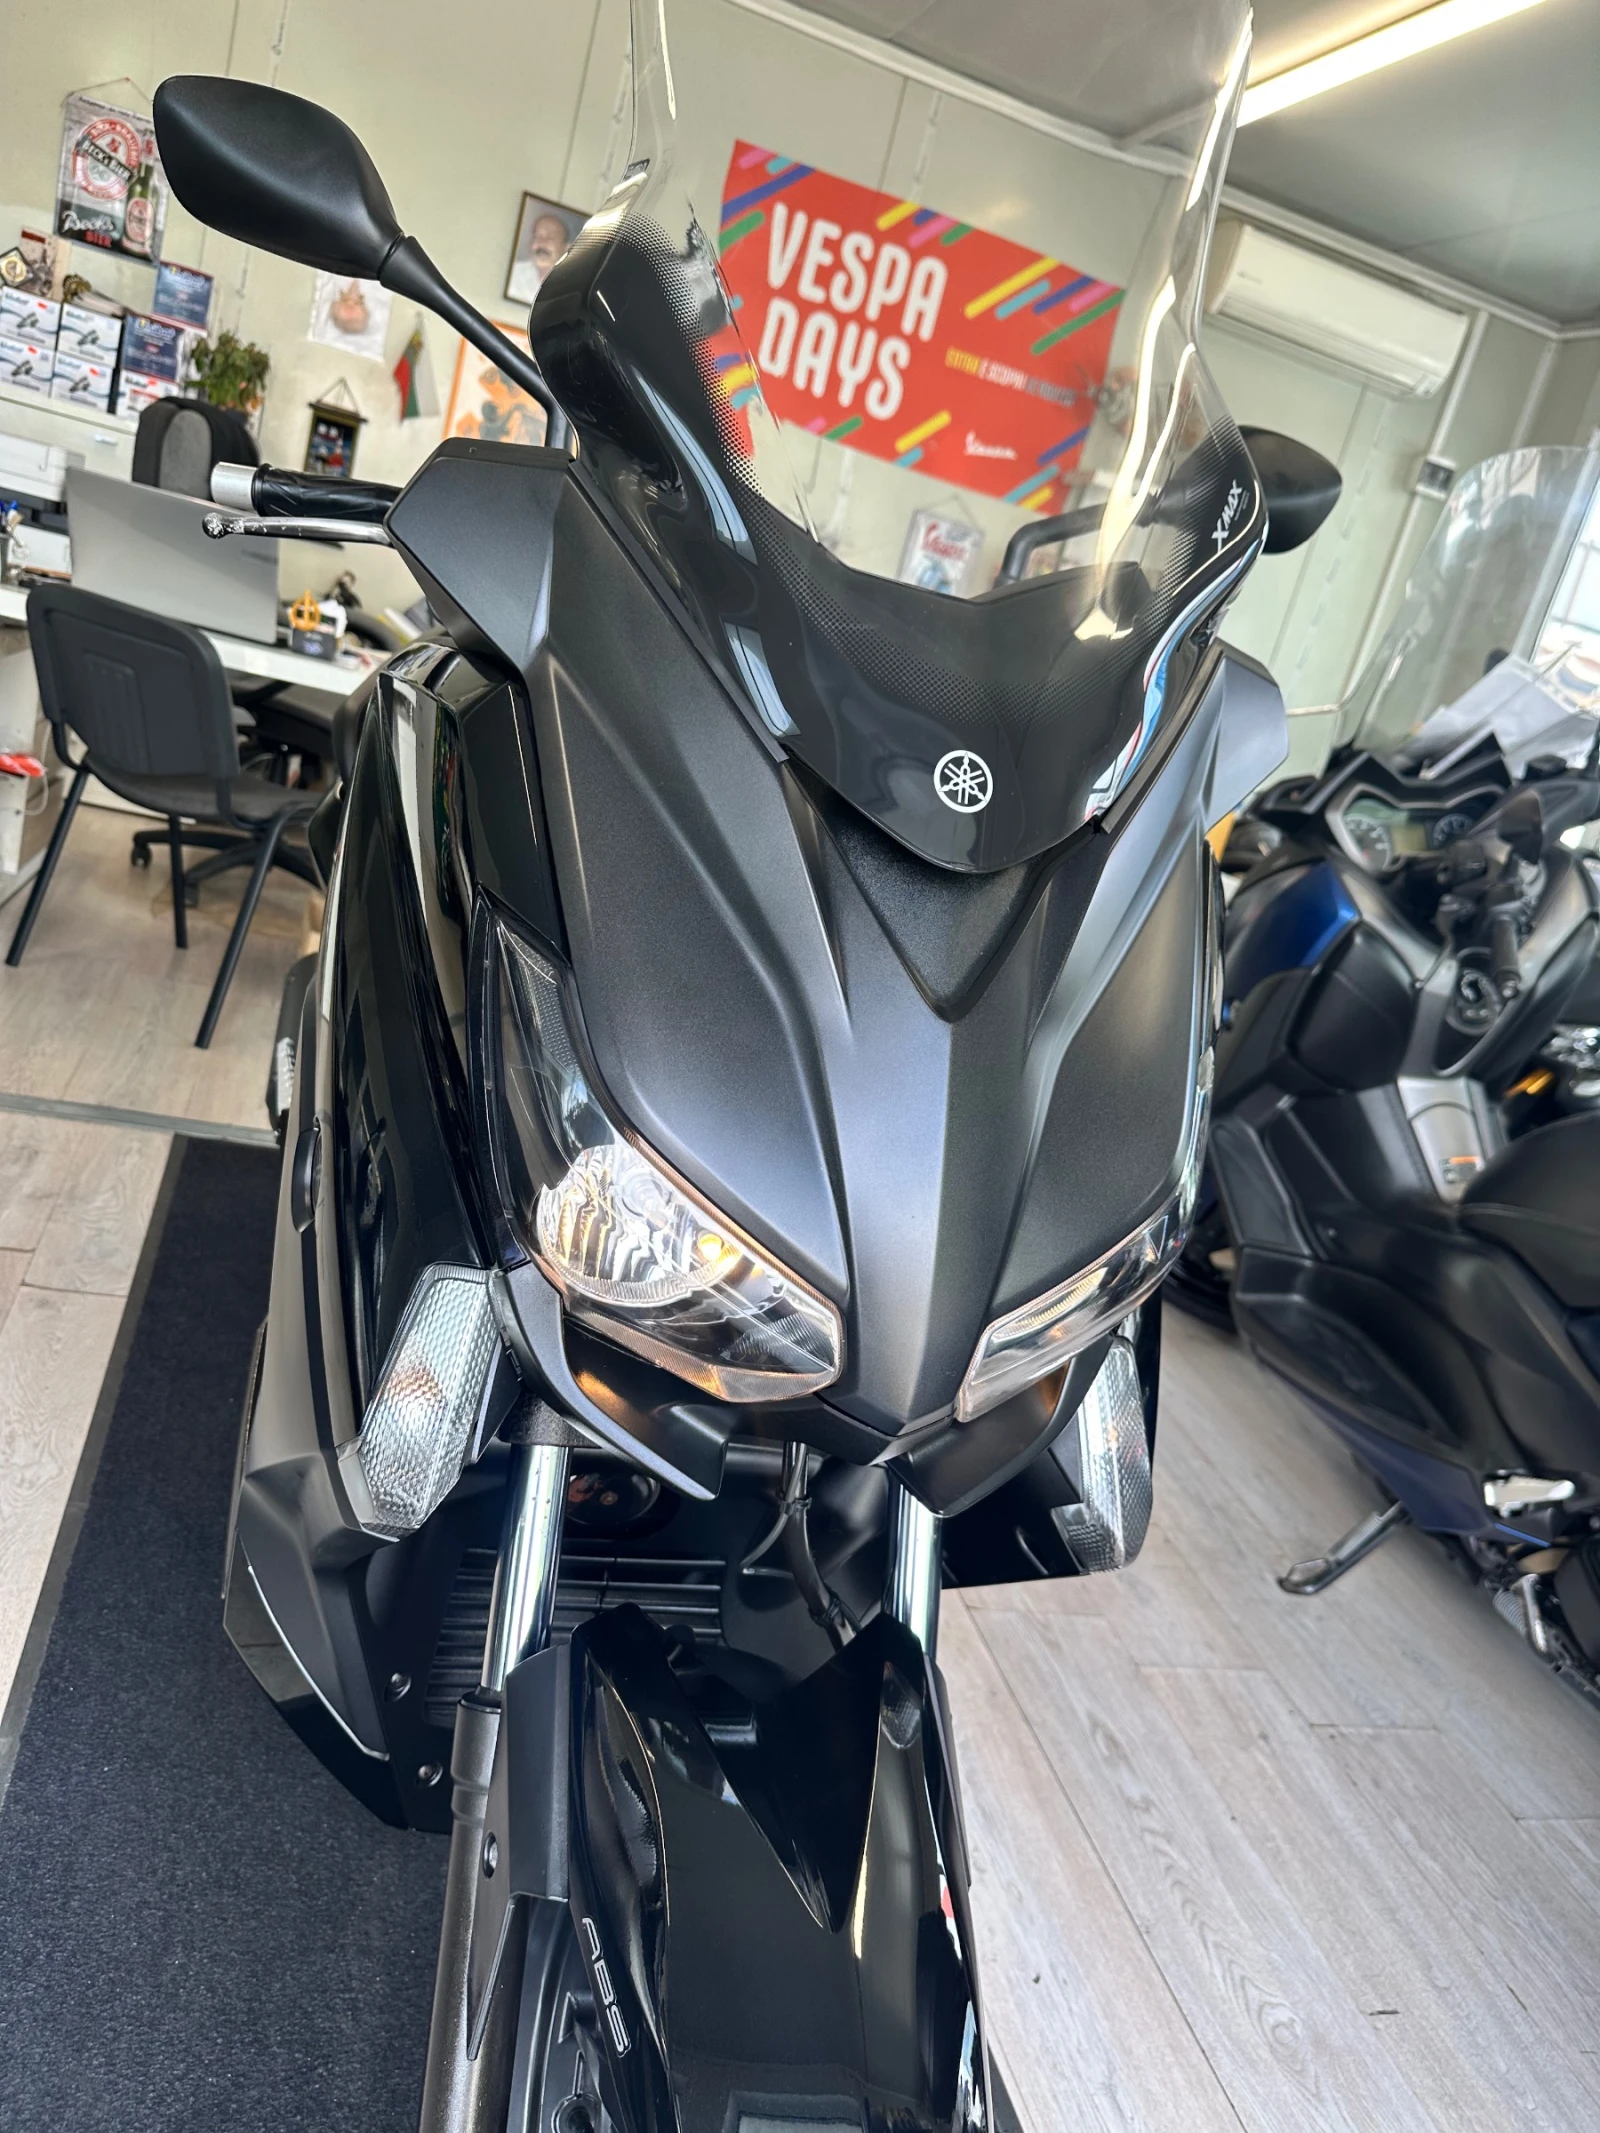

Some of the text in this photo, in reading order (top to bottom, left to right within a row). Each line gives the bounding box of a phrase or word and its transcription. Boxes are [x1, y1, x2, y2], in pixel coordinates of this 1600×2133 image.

[768, 202, 948, 342] VESPA
[757, 297, 911, 420] DAYS
[1211, 479, 1243, 553] XMAX
[582, 1917, 630, 2056] ABS
